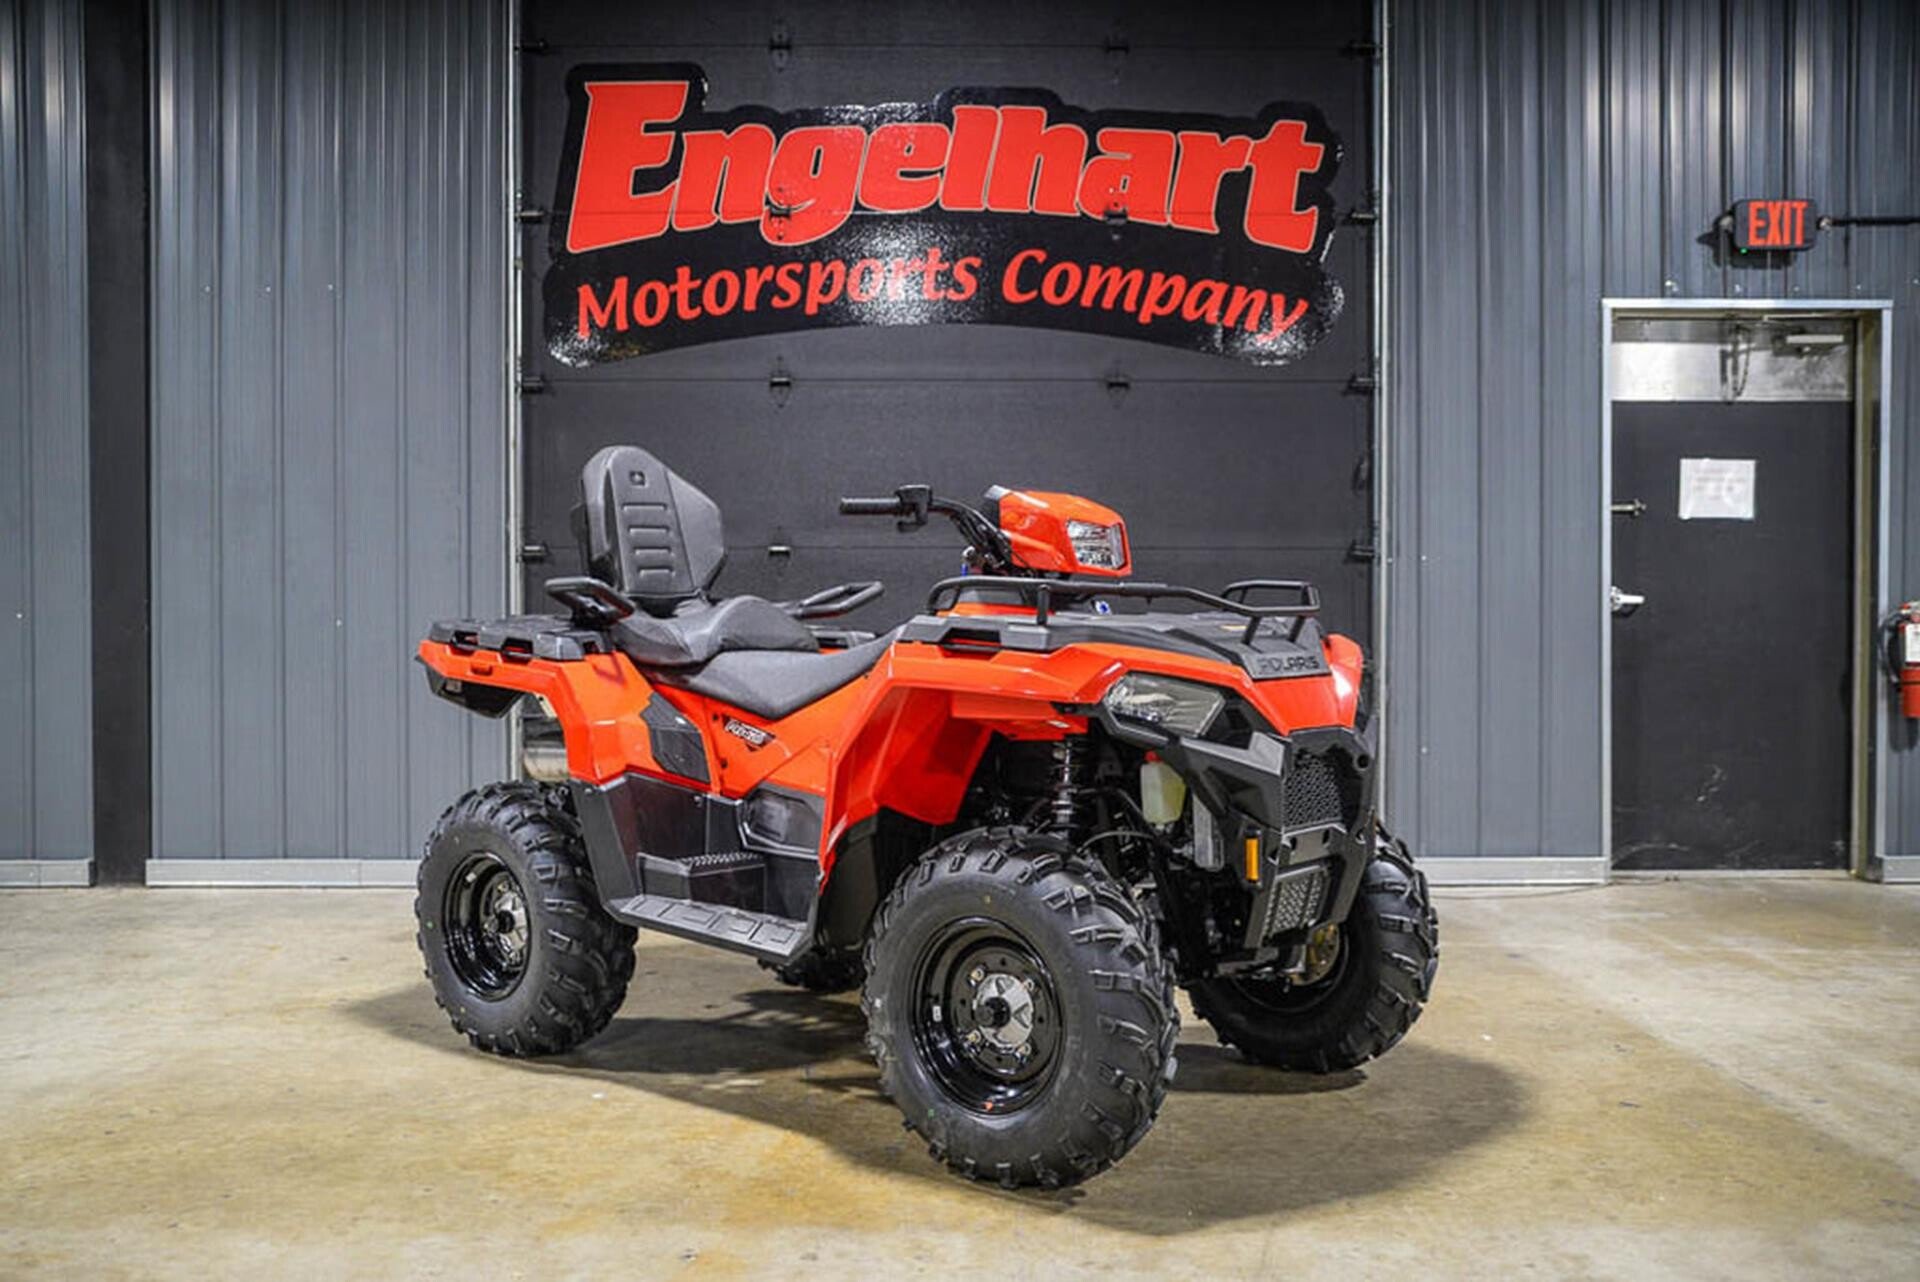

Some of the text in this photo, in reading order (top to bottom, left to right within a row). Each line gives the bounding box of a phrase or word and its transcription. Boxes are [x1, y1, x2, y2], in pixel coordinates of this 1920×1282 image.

[566, 80, 1325, 252] Engelhart
[1748, 200, 1808, 246] EXIT
[576, 246, 1309, 344] Motorsports Company
